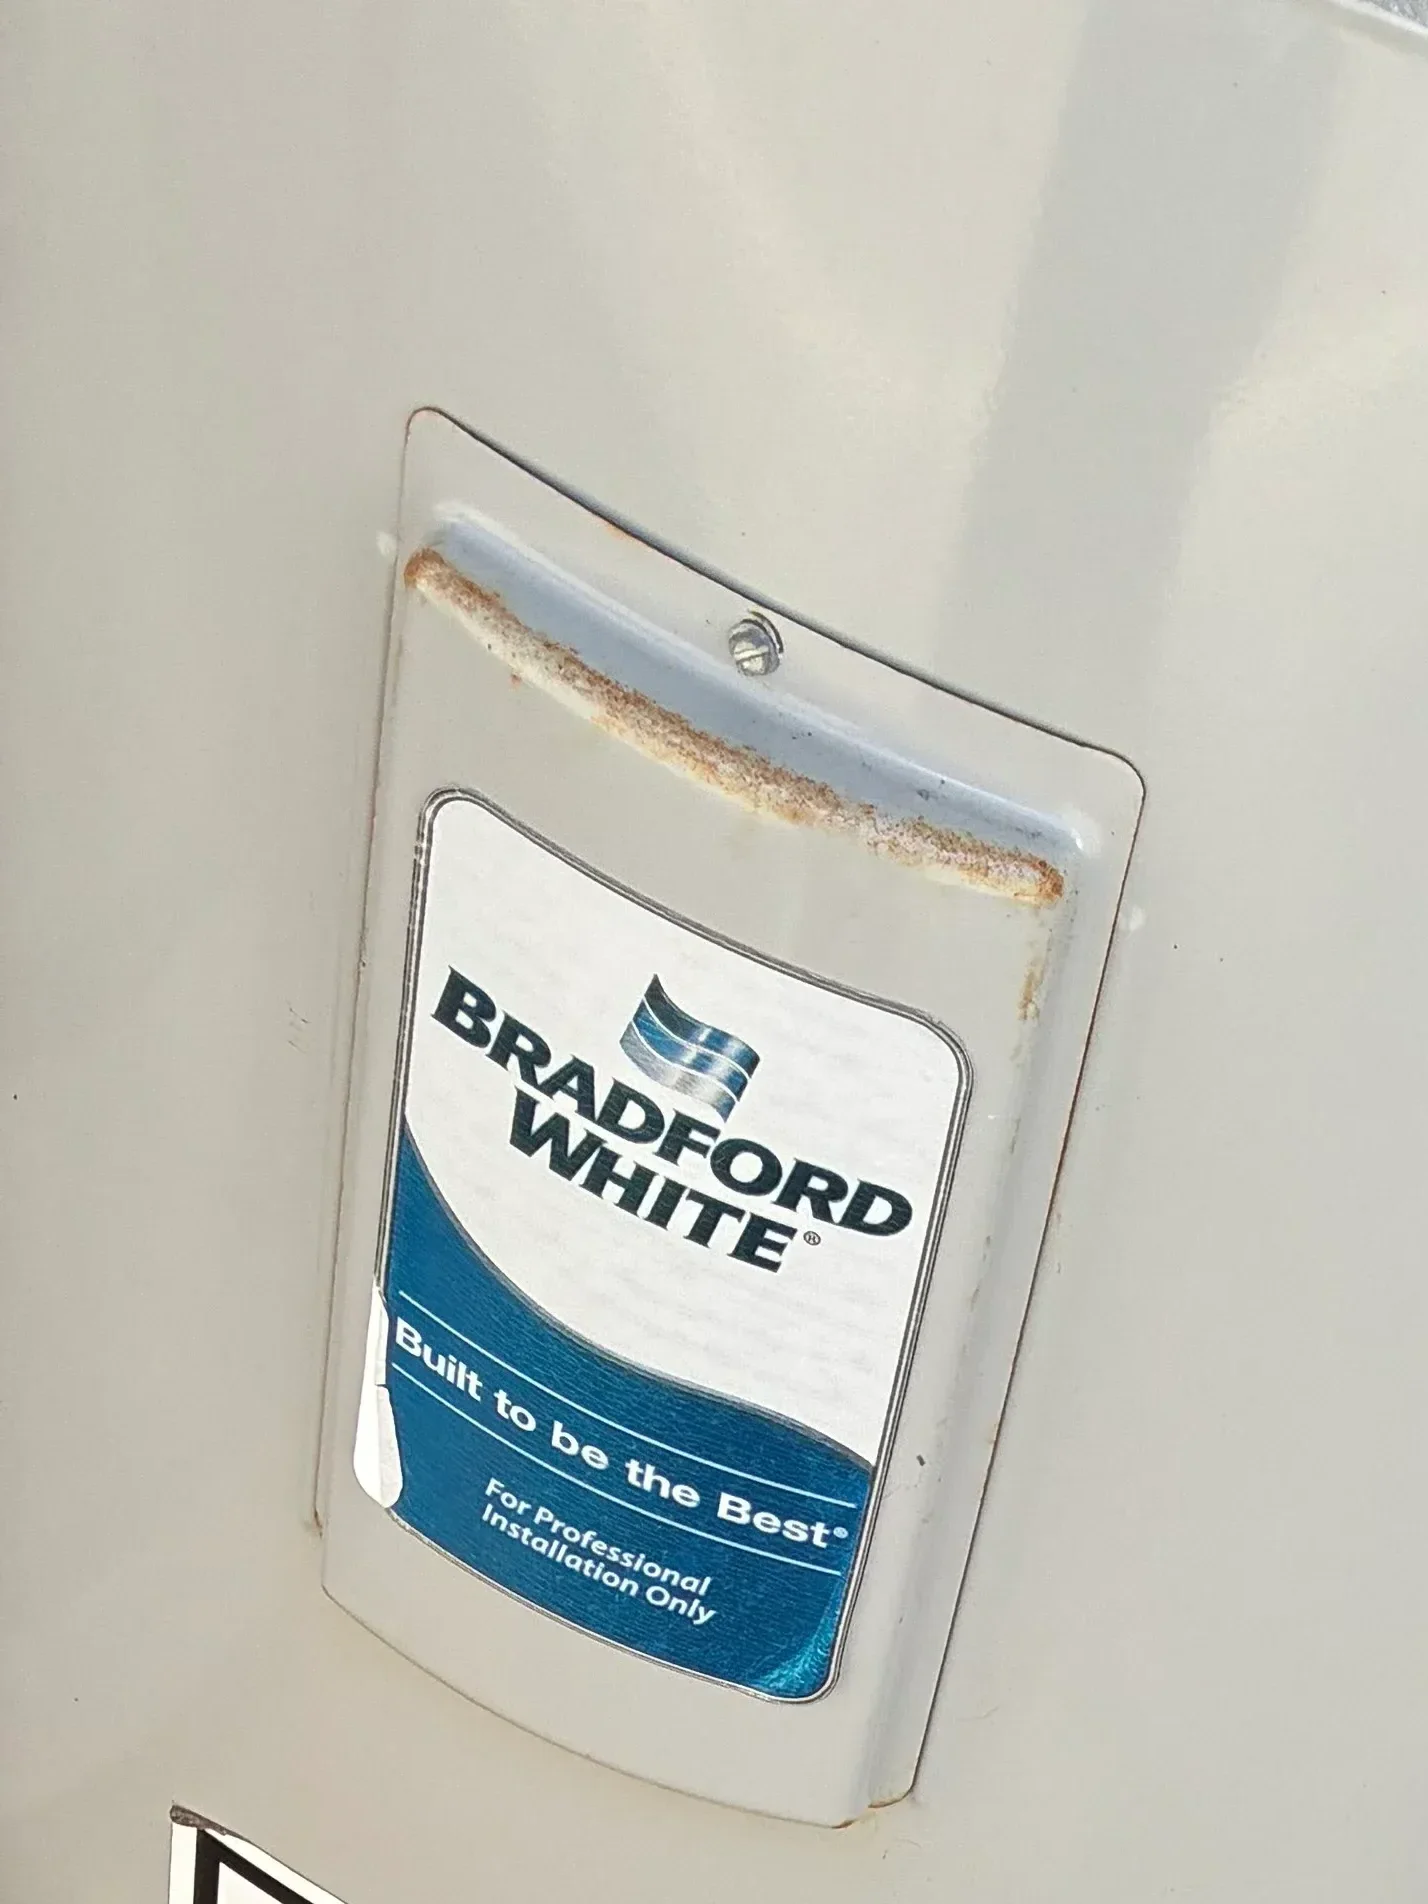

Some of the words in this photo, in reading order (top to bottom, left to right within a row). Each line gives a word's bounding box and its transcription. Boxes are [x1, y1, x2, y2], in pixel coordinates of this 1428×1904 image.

[430, 967, 914, 1238] BRADFORD
[395, 1317, 484, 1402] Built
[493, 1388, 537, 1431] to
[552, 1421, 610, 1470] be
[624, 1459, 701, 1508] the
[481, 1503, 640, 1597] Installation
[645, 1584, 717, 1627] Only
[485, 1478, 530, 1516] For
[534, 1505, 712, 1597] Professional
